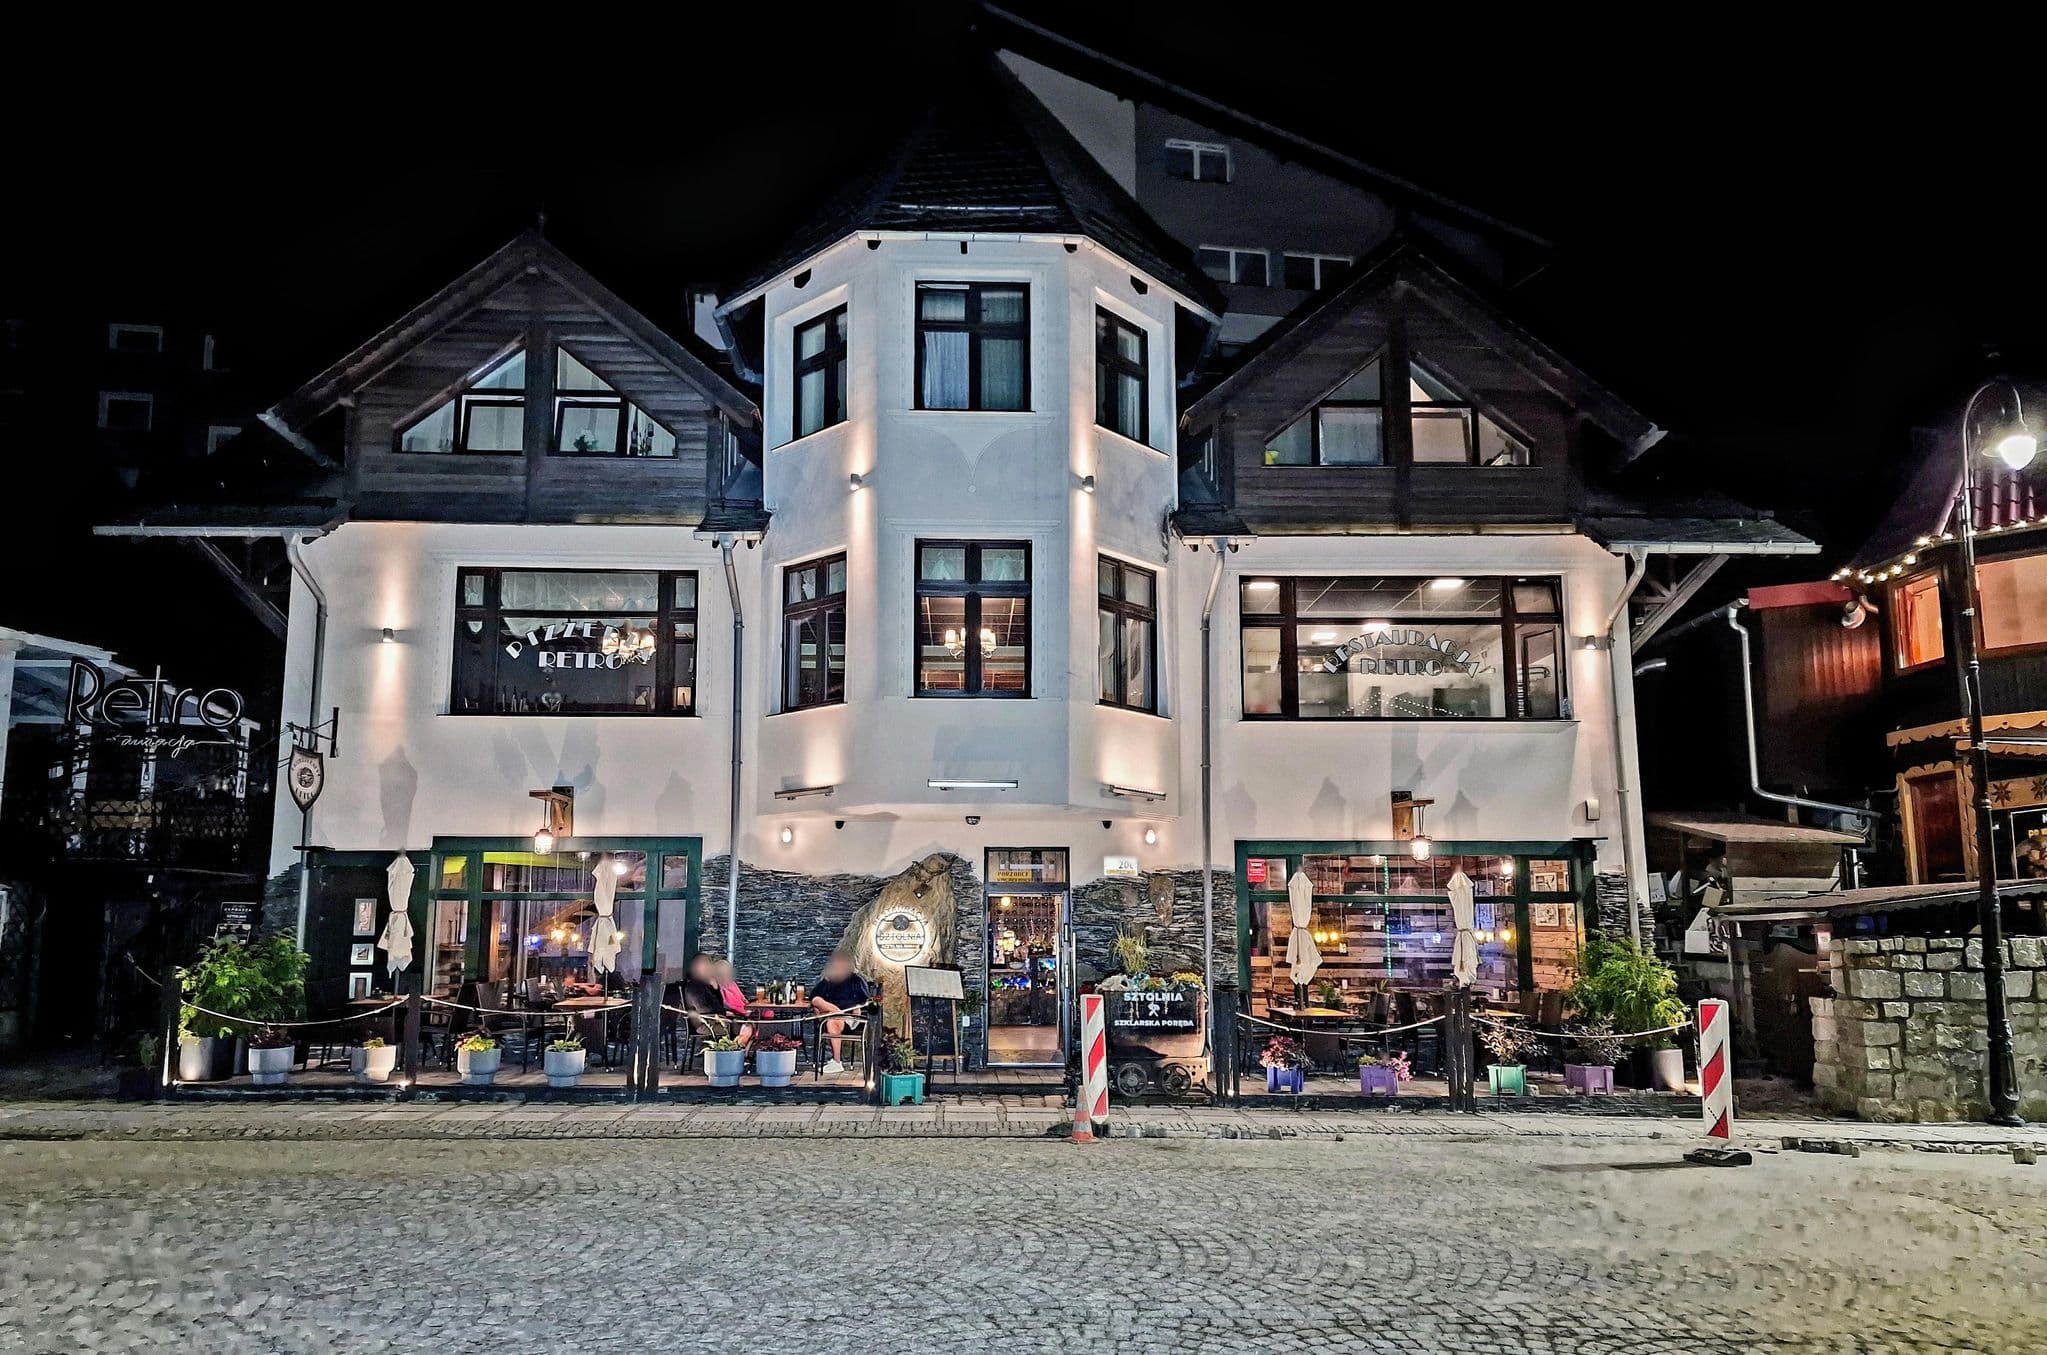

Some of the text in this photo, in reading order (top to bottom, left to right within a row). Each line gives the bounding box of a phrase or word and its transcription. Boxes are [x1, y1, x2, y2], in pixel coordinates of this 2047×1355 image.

[538, 651, 623, 669] RETRO
[1323, 629, 1480, 678] RESTAURACJA
[1360, 657, 1444, 677] RETRO
[66, 661, 243, 728] Retro
[1123, 992, 1184, 1002] SZTOLNIA
